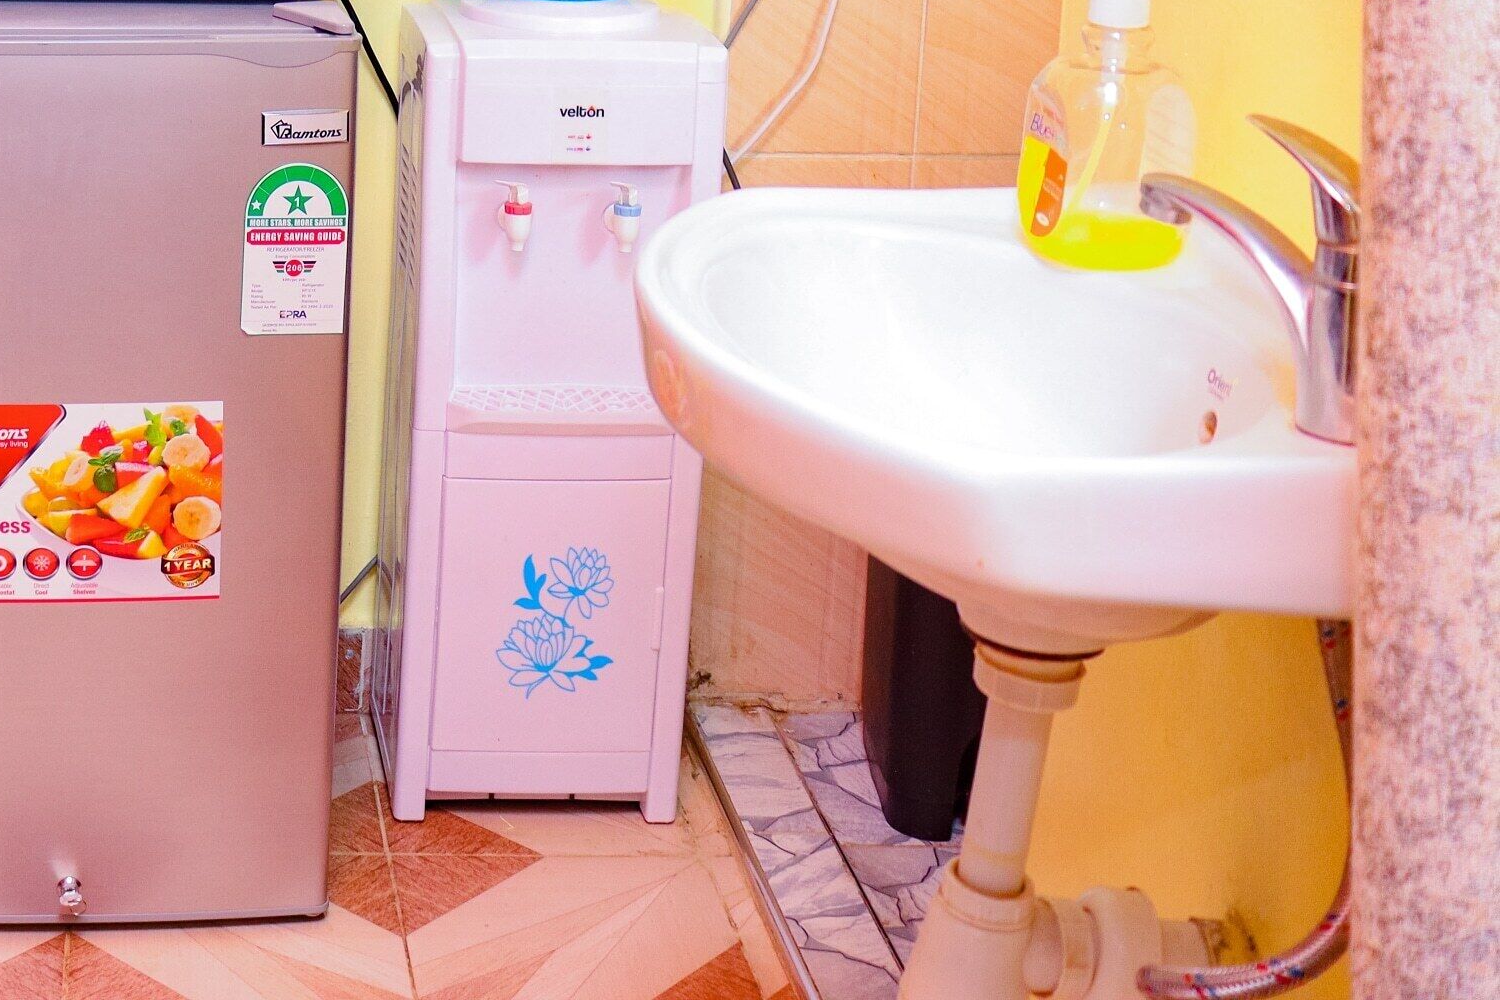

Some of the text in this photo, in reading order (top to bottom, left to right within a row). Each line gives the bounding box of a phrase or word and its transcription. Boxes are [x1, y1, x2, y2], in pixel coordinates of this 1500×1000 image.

[275, 123, 342, 140] Ramtons
[294, 196, 300, 208] 1
[250, 218, 343, 227] MORE STARS, MORE SAVINGS
[251, 231, 342, 241] ENERGY SAVING GUIDE
[287, 264, 302, 272] 206
[280, 310, 307, 319] EPRA
[10, 440, 28, 449] living
[164, 558, 212, 572] 1 YEAR
